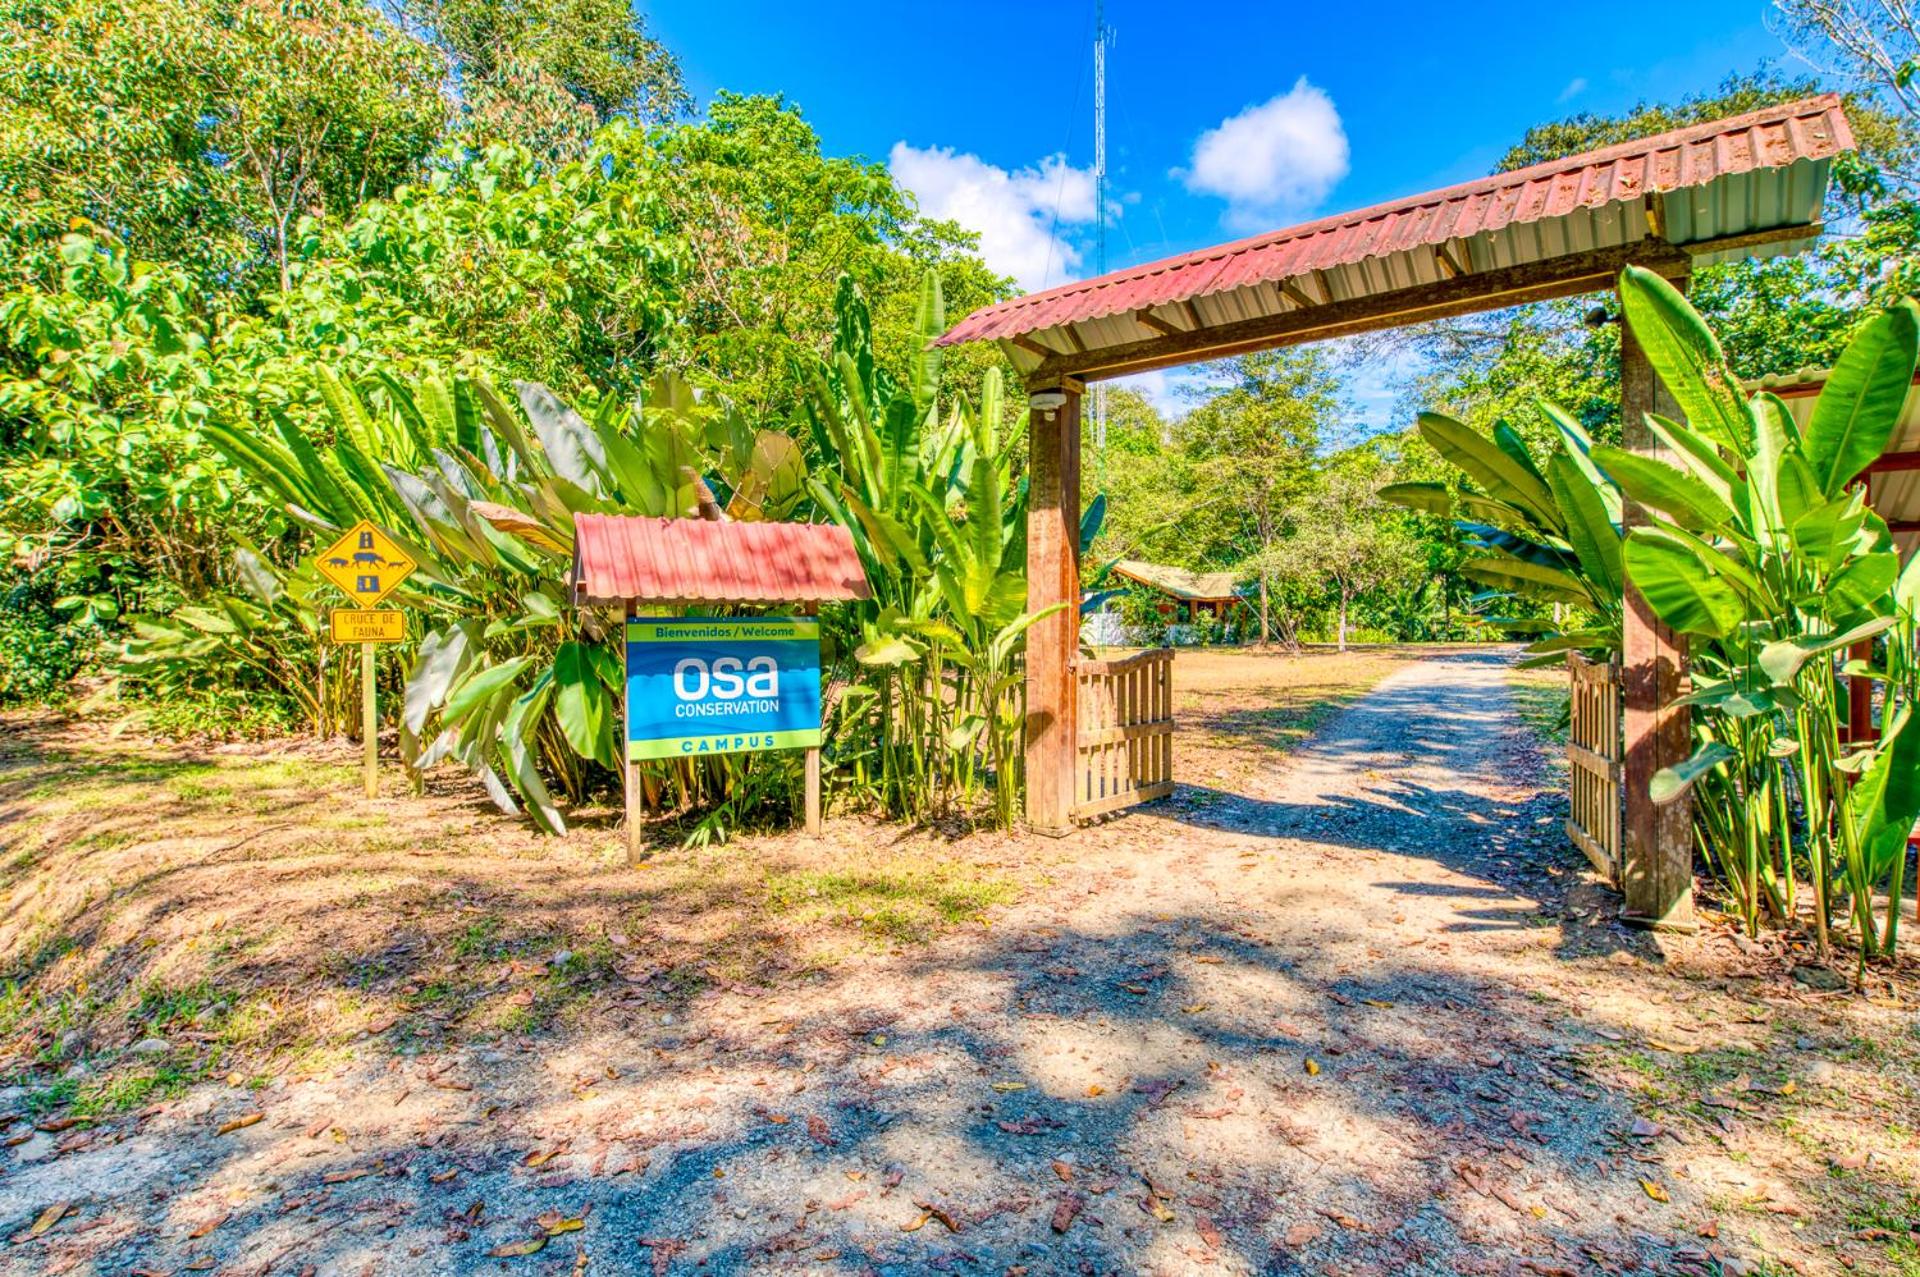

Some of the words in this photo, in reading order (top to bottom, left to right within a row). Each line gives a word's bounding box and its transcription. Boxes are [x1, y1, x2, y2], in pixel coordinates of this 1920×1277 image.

[343, 613, 376, 625] CRUCE
[382, 613, 396, 624] DE
[353, 626, 385, 637] FAUNA
[656, 626, 731, 638] Bienvenidos
[742, 626, 795, 637] Welcome
[674, 656, 779, 701] osa
[675, 699, 779, 718] CONSERVATION
[681, 735, 774, 753] CAMPUS
